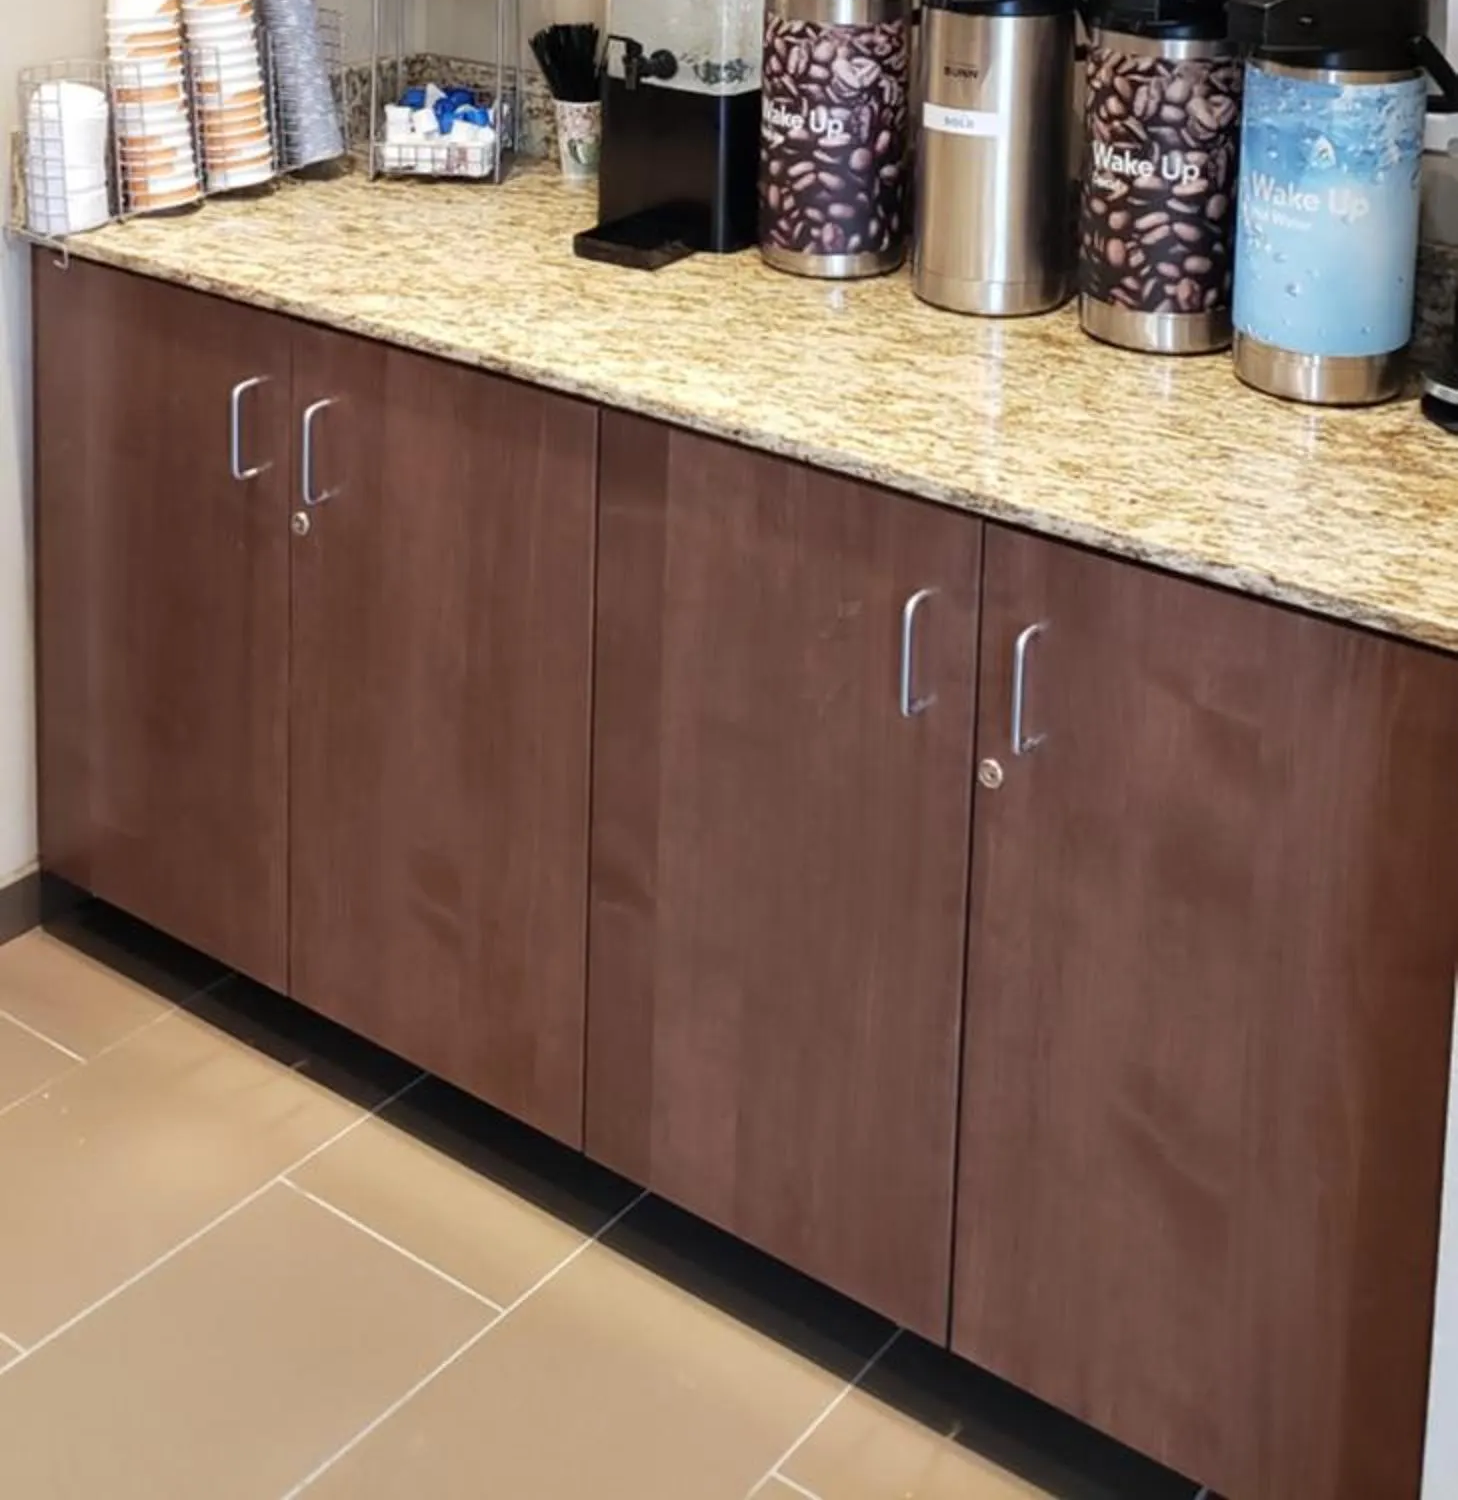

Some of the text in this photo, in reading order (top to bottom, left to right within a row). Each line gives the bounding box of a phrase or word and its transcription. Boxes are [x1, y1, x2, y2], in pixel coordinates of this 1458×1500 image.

[809, 108, 844, 140] Up
[1092, 140, 1154, 177] Wake
[1161, 154, 1200, 186] Up
[1252, 170, 1370, 223] Wake Up
